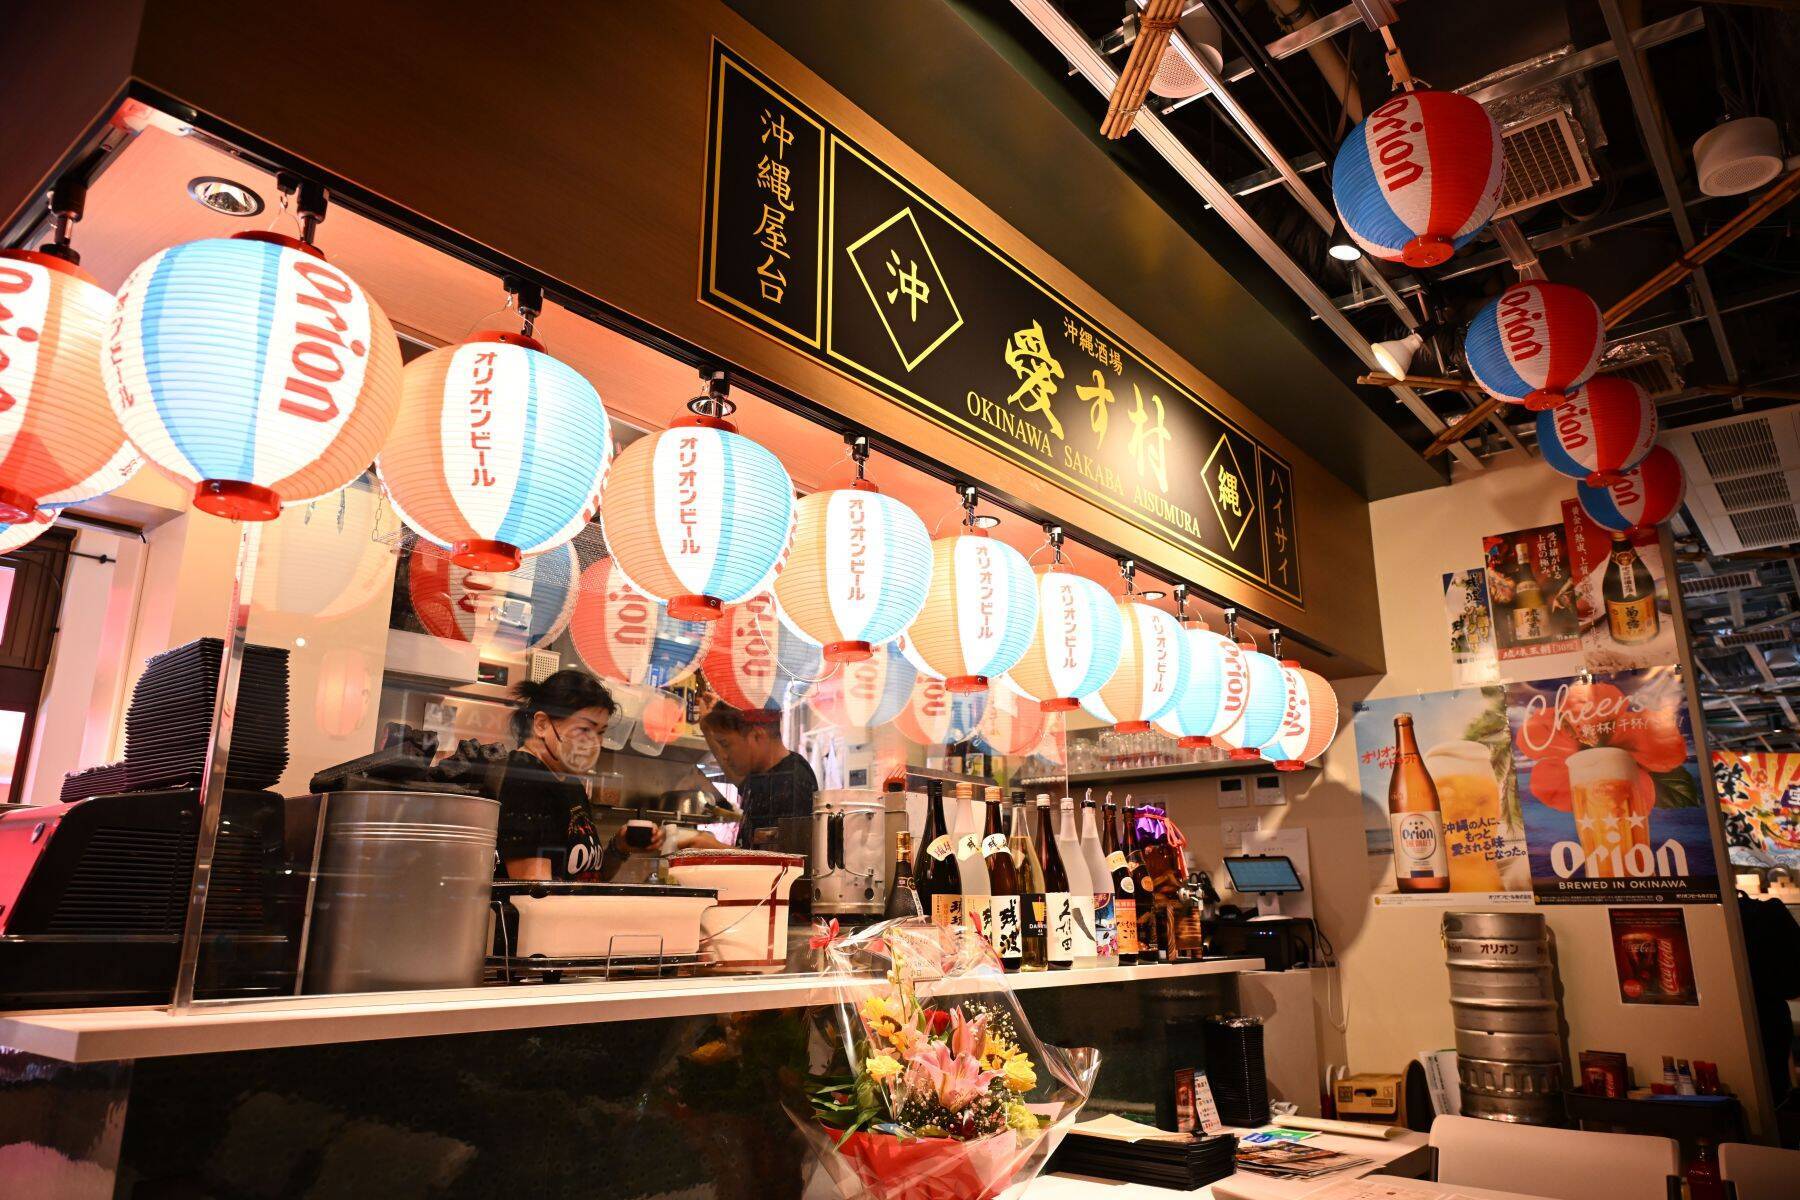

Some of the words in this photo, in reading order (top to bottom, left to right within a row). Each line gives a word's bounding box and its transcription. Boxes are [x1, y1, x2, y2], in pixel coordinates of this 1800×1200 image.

[752, 107, 796, 305] 沖縄屋台
[885, 248, 930, 323] 沖
[1062, 315, 1124, 377] 沖縄酒場
[469, 351, 499, 487] オリオンビール
[1004, 317, 1173, 494] 愛す村
[678, 436, 701, 554] オリオンビール
[966, 390, 1054, 459] OKINAWA
[1063, 443, 1126, 497] SAKABA
[1132, 483, 1202, 539] AISUMURA
[1217, 464, 1242, 518] 縄
[846, 499, 867, 602] オリオンビール
[1269, 467, 1289, 586] ハイサイ
[975, 544, 995, 640] オリオンビール
[1060, 583, 1079, 670] オリオンビール
[1151, 613, 1167, 693] オリオンビール
[1451, 835, 1504, 857] 愛される味
[1465, 828, 1491, 840] もっと
[1558, 881, 1609, 890] BREWED
[1613, 880, 1626, 889] IN
[1629, 879, 1687, 889] OKINAWA
[1480, 943, 1519, 955] オリオン
